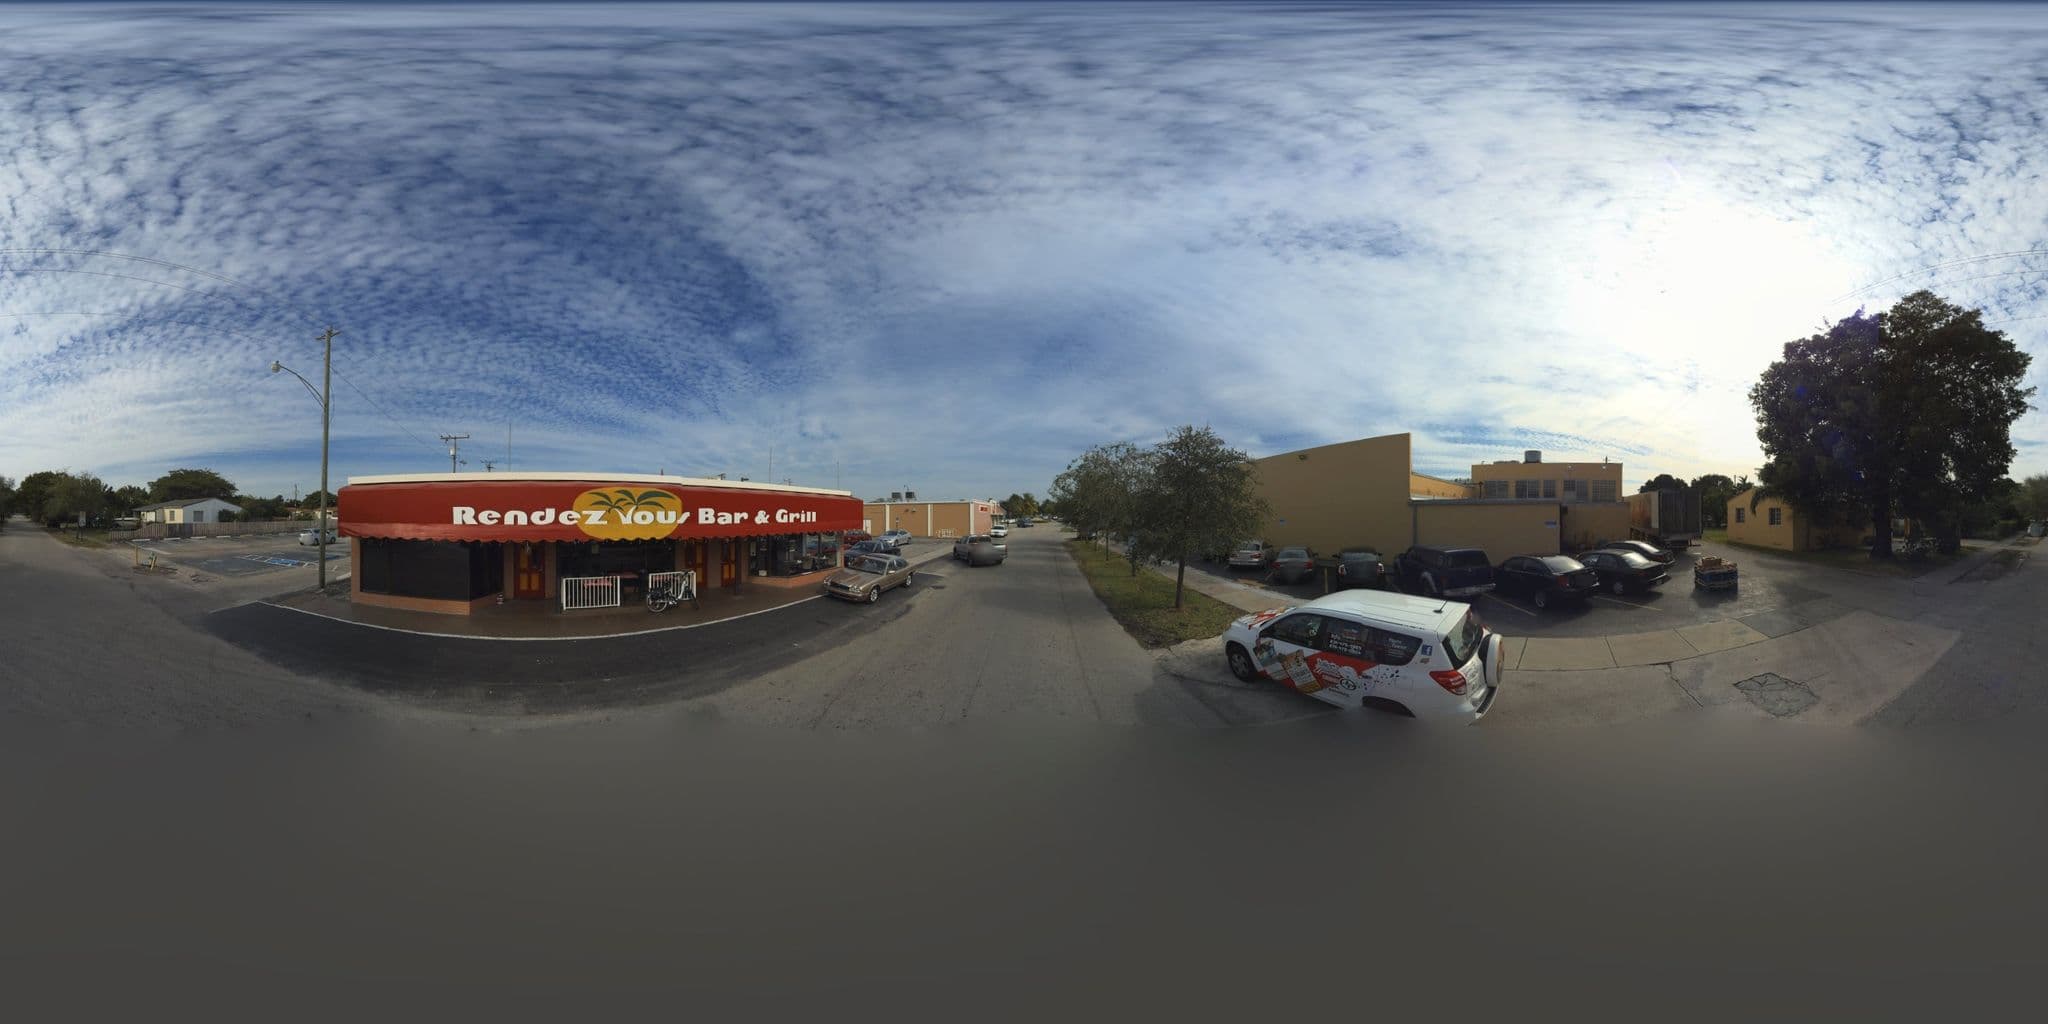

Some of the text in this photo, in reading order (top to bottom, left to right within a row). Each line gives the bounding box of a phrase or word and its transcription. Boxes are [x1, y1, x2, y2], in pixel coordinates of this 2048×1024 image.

[452, 506, 608, 526] Rendez
[698, 508, 748, 525] Bar
[754, 510, 770, 524] &
[775, 509, 817, 523] Grill
